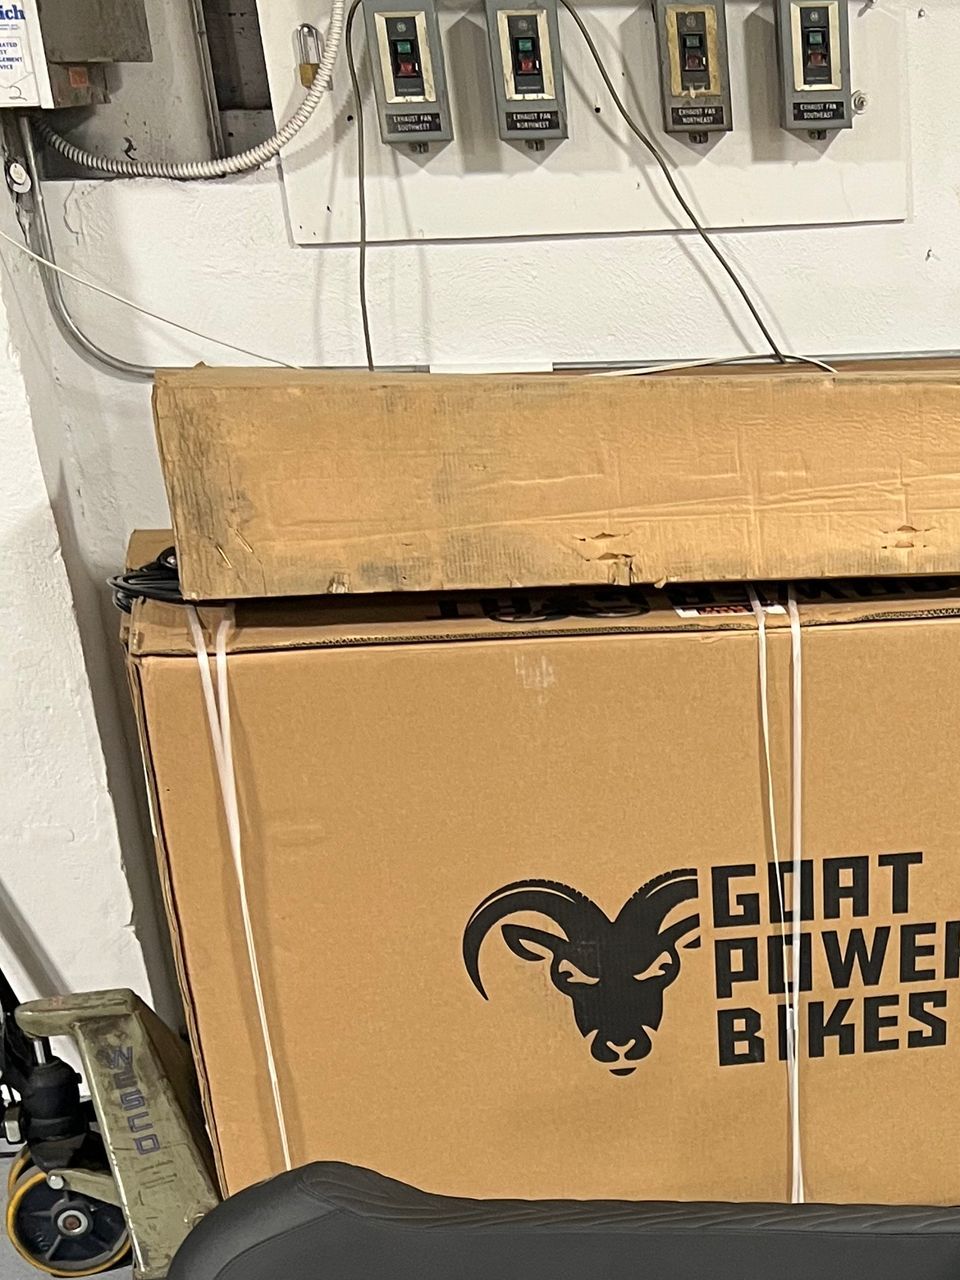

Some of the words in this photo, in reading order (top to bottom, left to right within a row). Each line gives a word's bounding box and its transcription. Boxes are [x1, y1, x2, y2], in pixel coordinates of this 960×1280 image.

[539, 112, 551, 120] FAN
[711, 851, 923, 928] GOAT
[717, 990, 948, 1067] BIKES
[108, 1046, 161, 1155] WESCO
